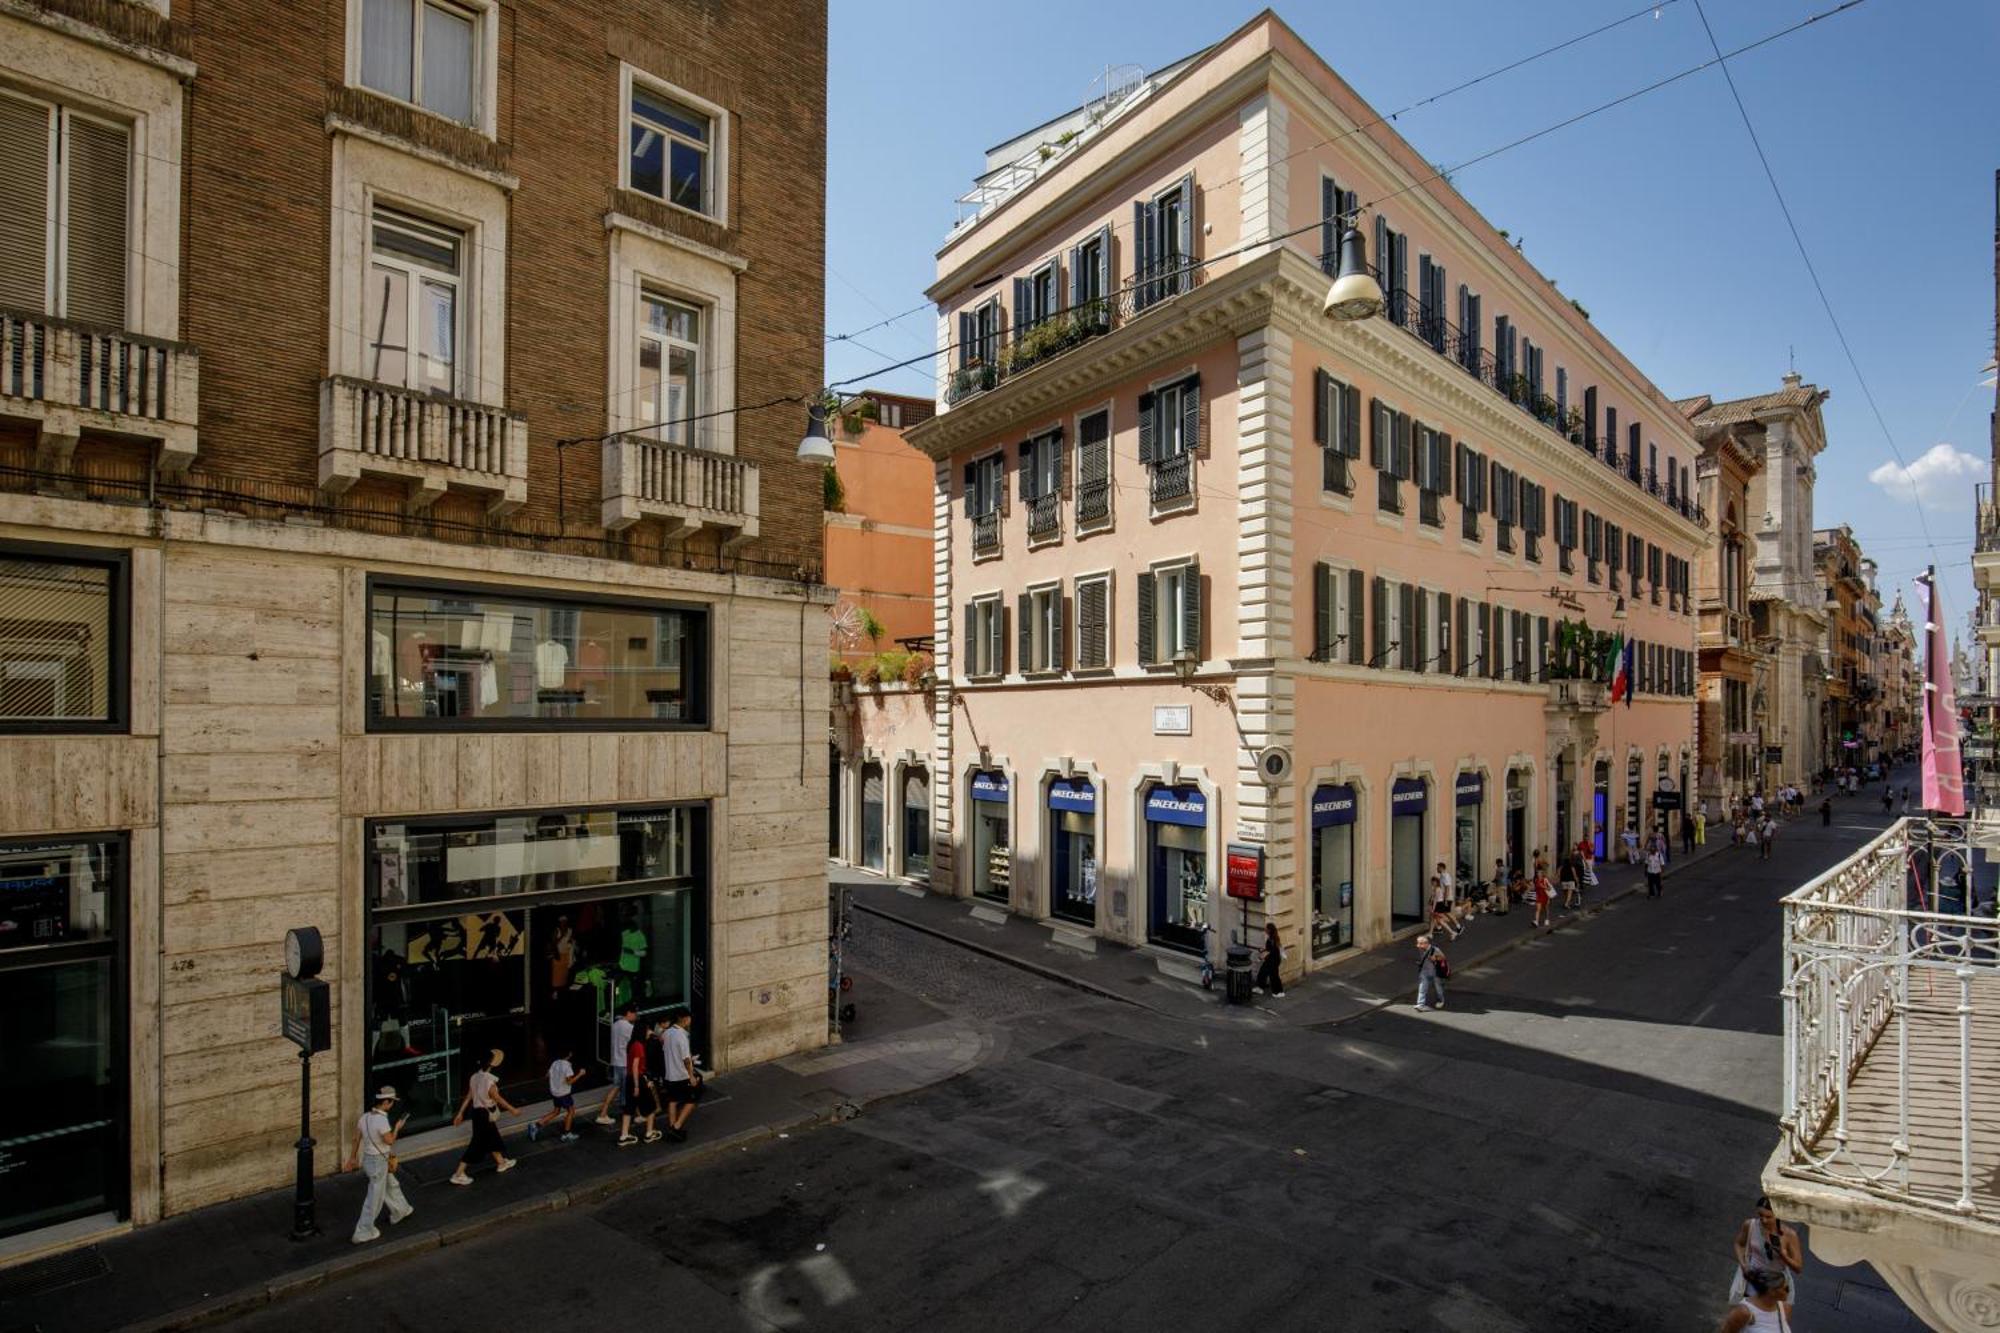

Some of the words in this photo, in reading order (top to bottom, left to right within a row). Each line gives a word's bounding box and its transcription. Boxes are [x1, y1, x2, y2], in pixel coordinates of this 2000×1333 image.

[1051, 789, 1094, 801] SKECHERS
[1148, 798, 1204, 812] SKECHERS
[1313, 799, 1353, 813] SKECHERS
